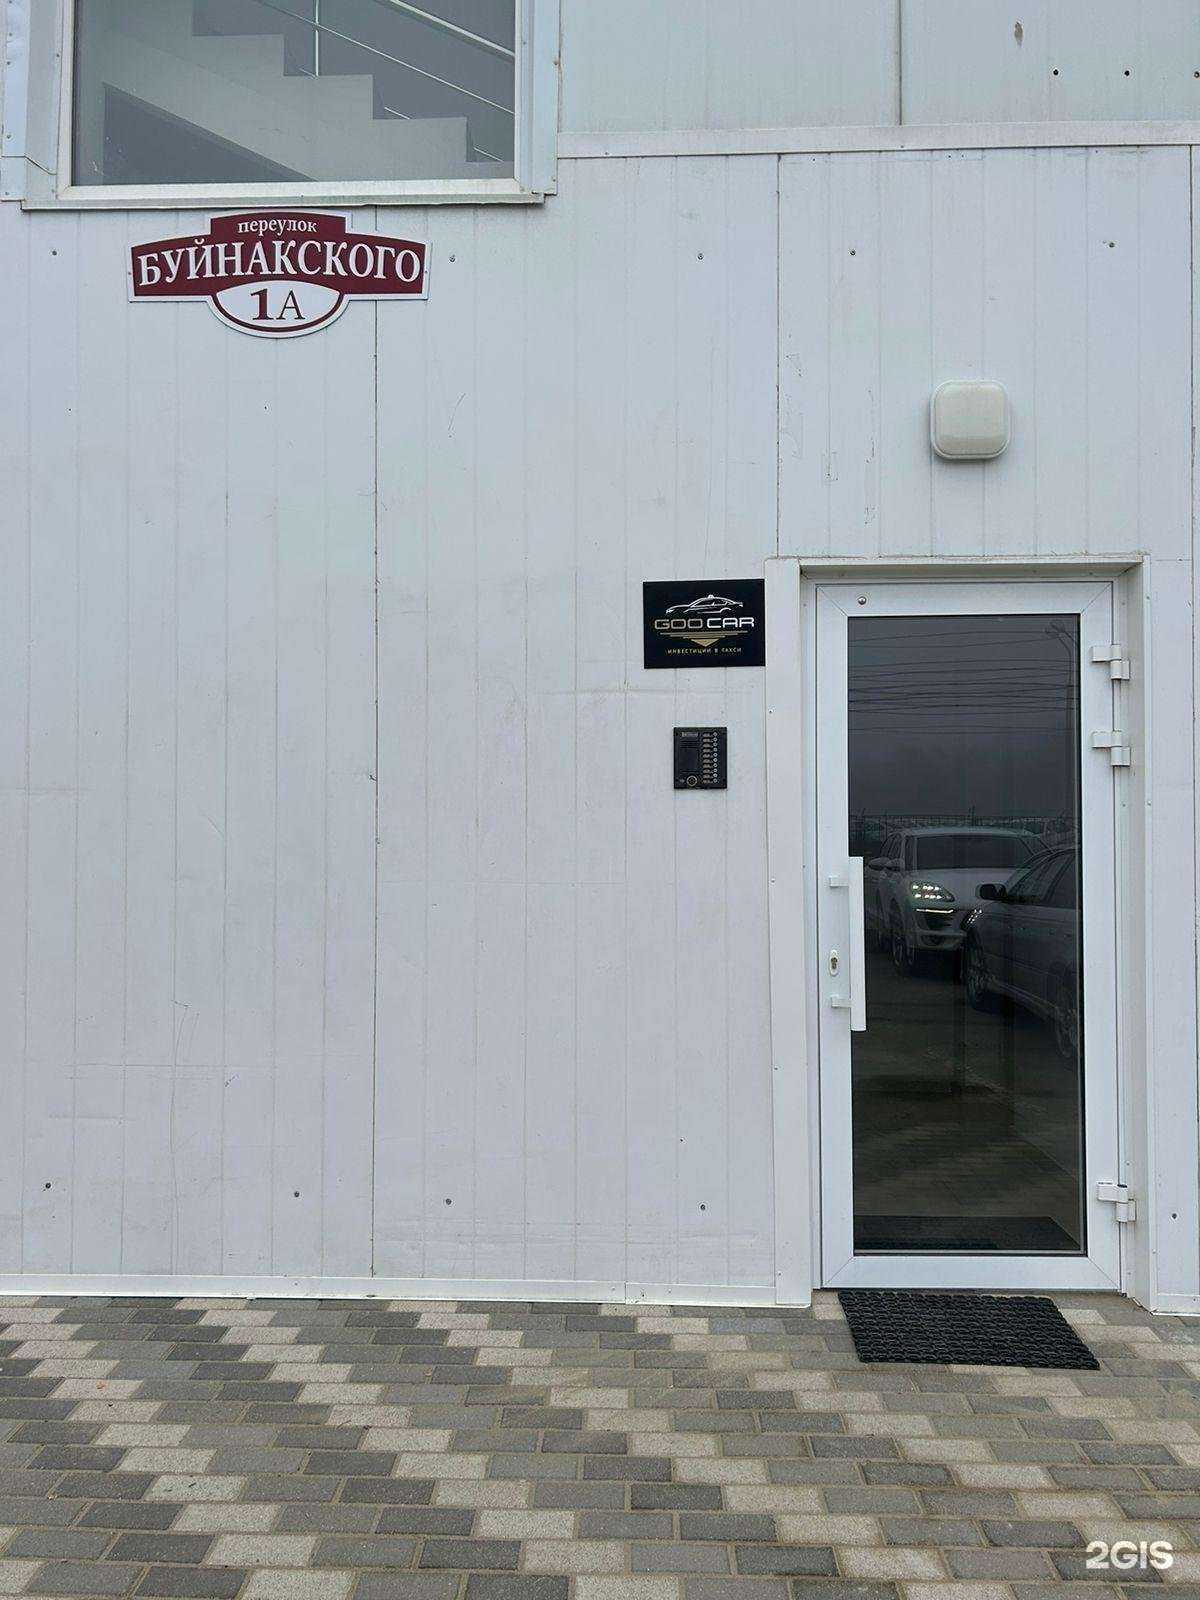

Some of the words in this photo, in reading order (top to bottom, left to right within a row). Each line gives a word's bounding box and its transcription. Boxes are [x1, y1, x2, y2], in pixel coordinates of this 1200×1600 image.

[237, 217, 318, 238] переулок
[138, 238, 421, 286] БУЙНАКСКОГО
[706, 617, 755, 629] CAR
[667, 647, 711, 655] ИНВЕСТИЦИИ
